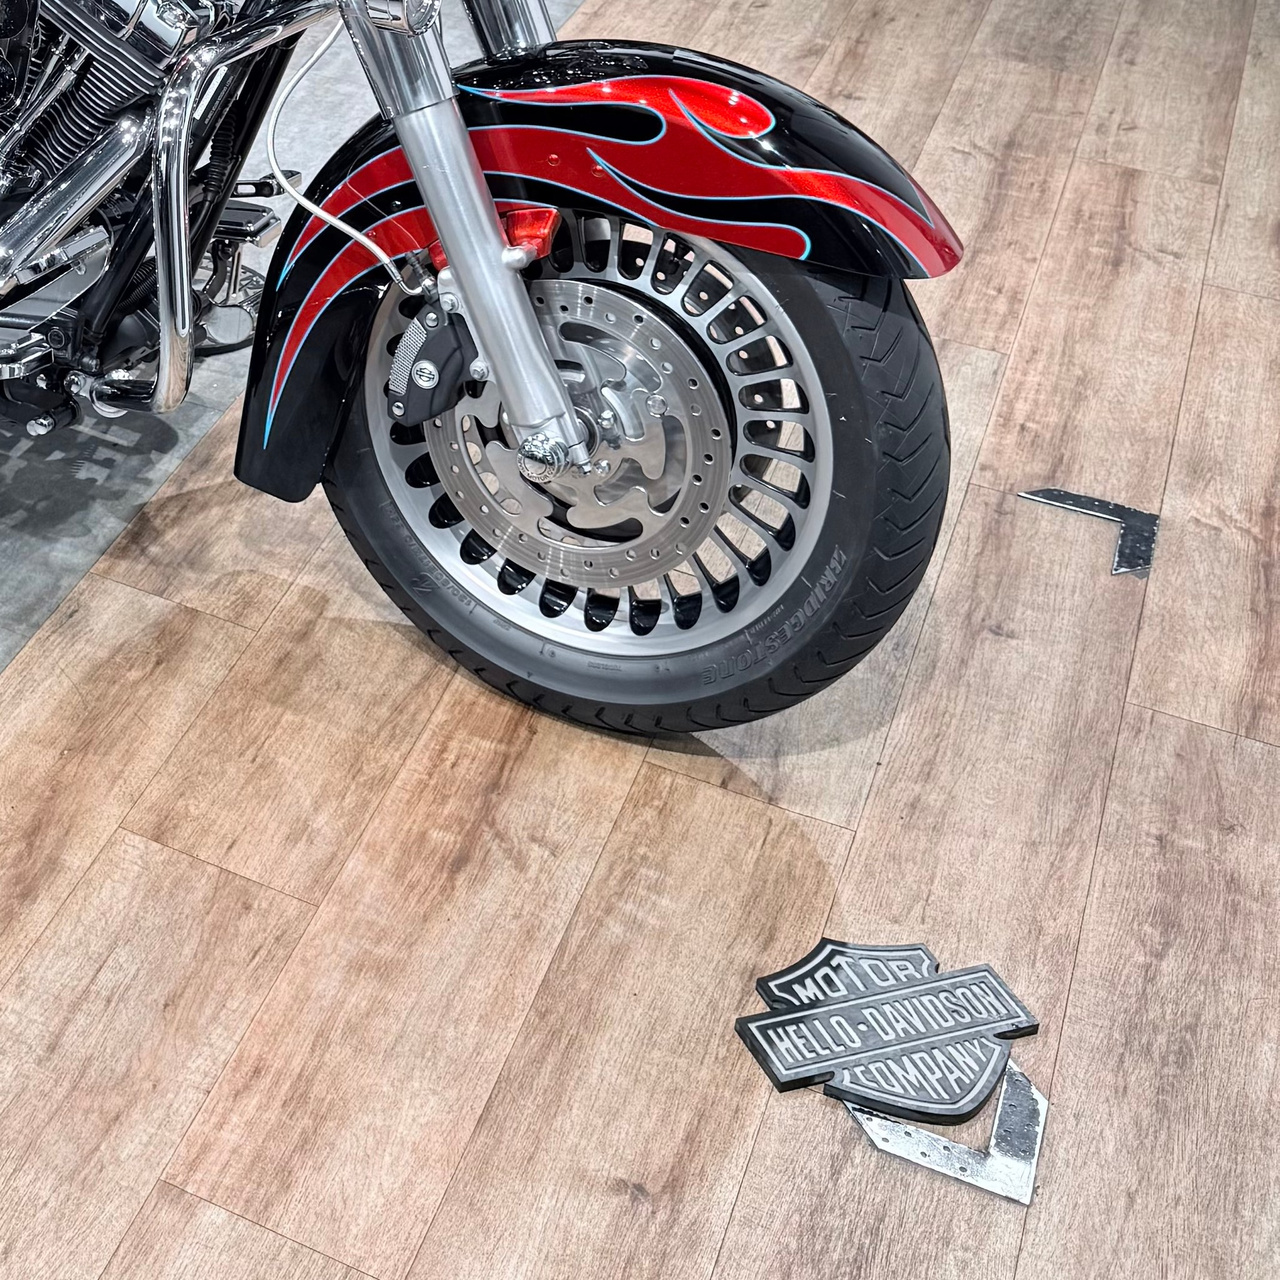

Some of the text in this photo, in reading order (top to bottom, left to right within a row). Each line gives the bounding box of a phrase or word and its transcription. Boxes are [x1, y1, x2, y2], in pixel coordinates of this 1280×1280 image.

[701, 544, 848, 686] BRIDGESTONE
[791, 956, 923, 1005] MOTOR
[766, 981, 1007, 1064] HELLO DAVIDSON
[858, 1037, 987, 1099] COMPANY
